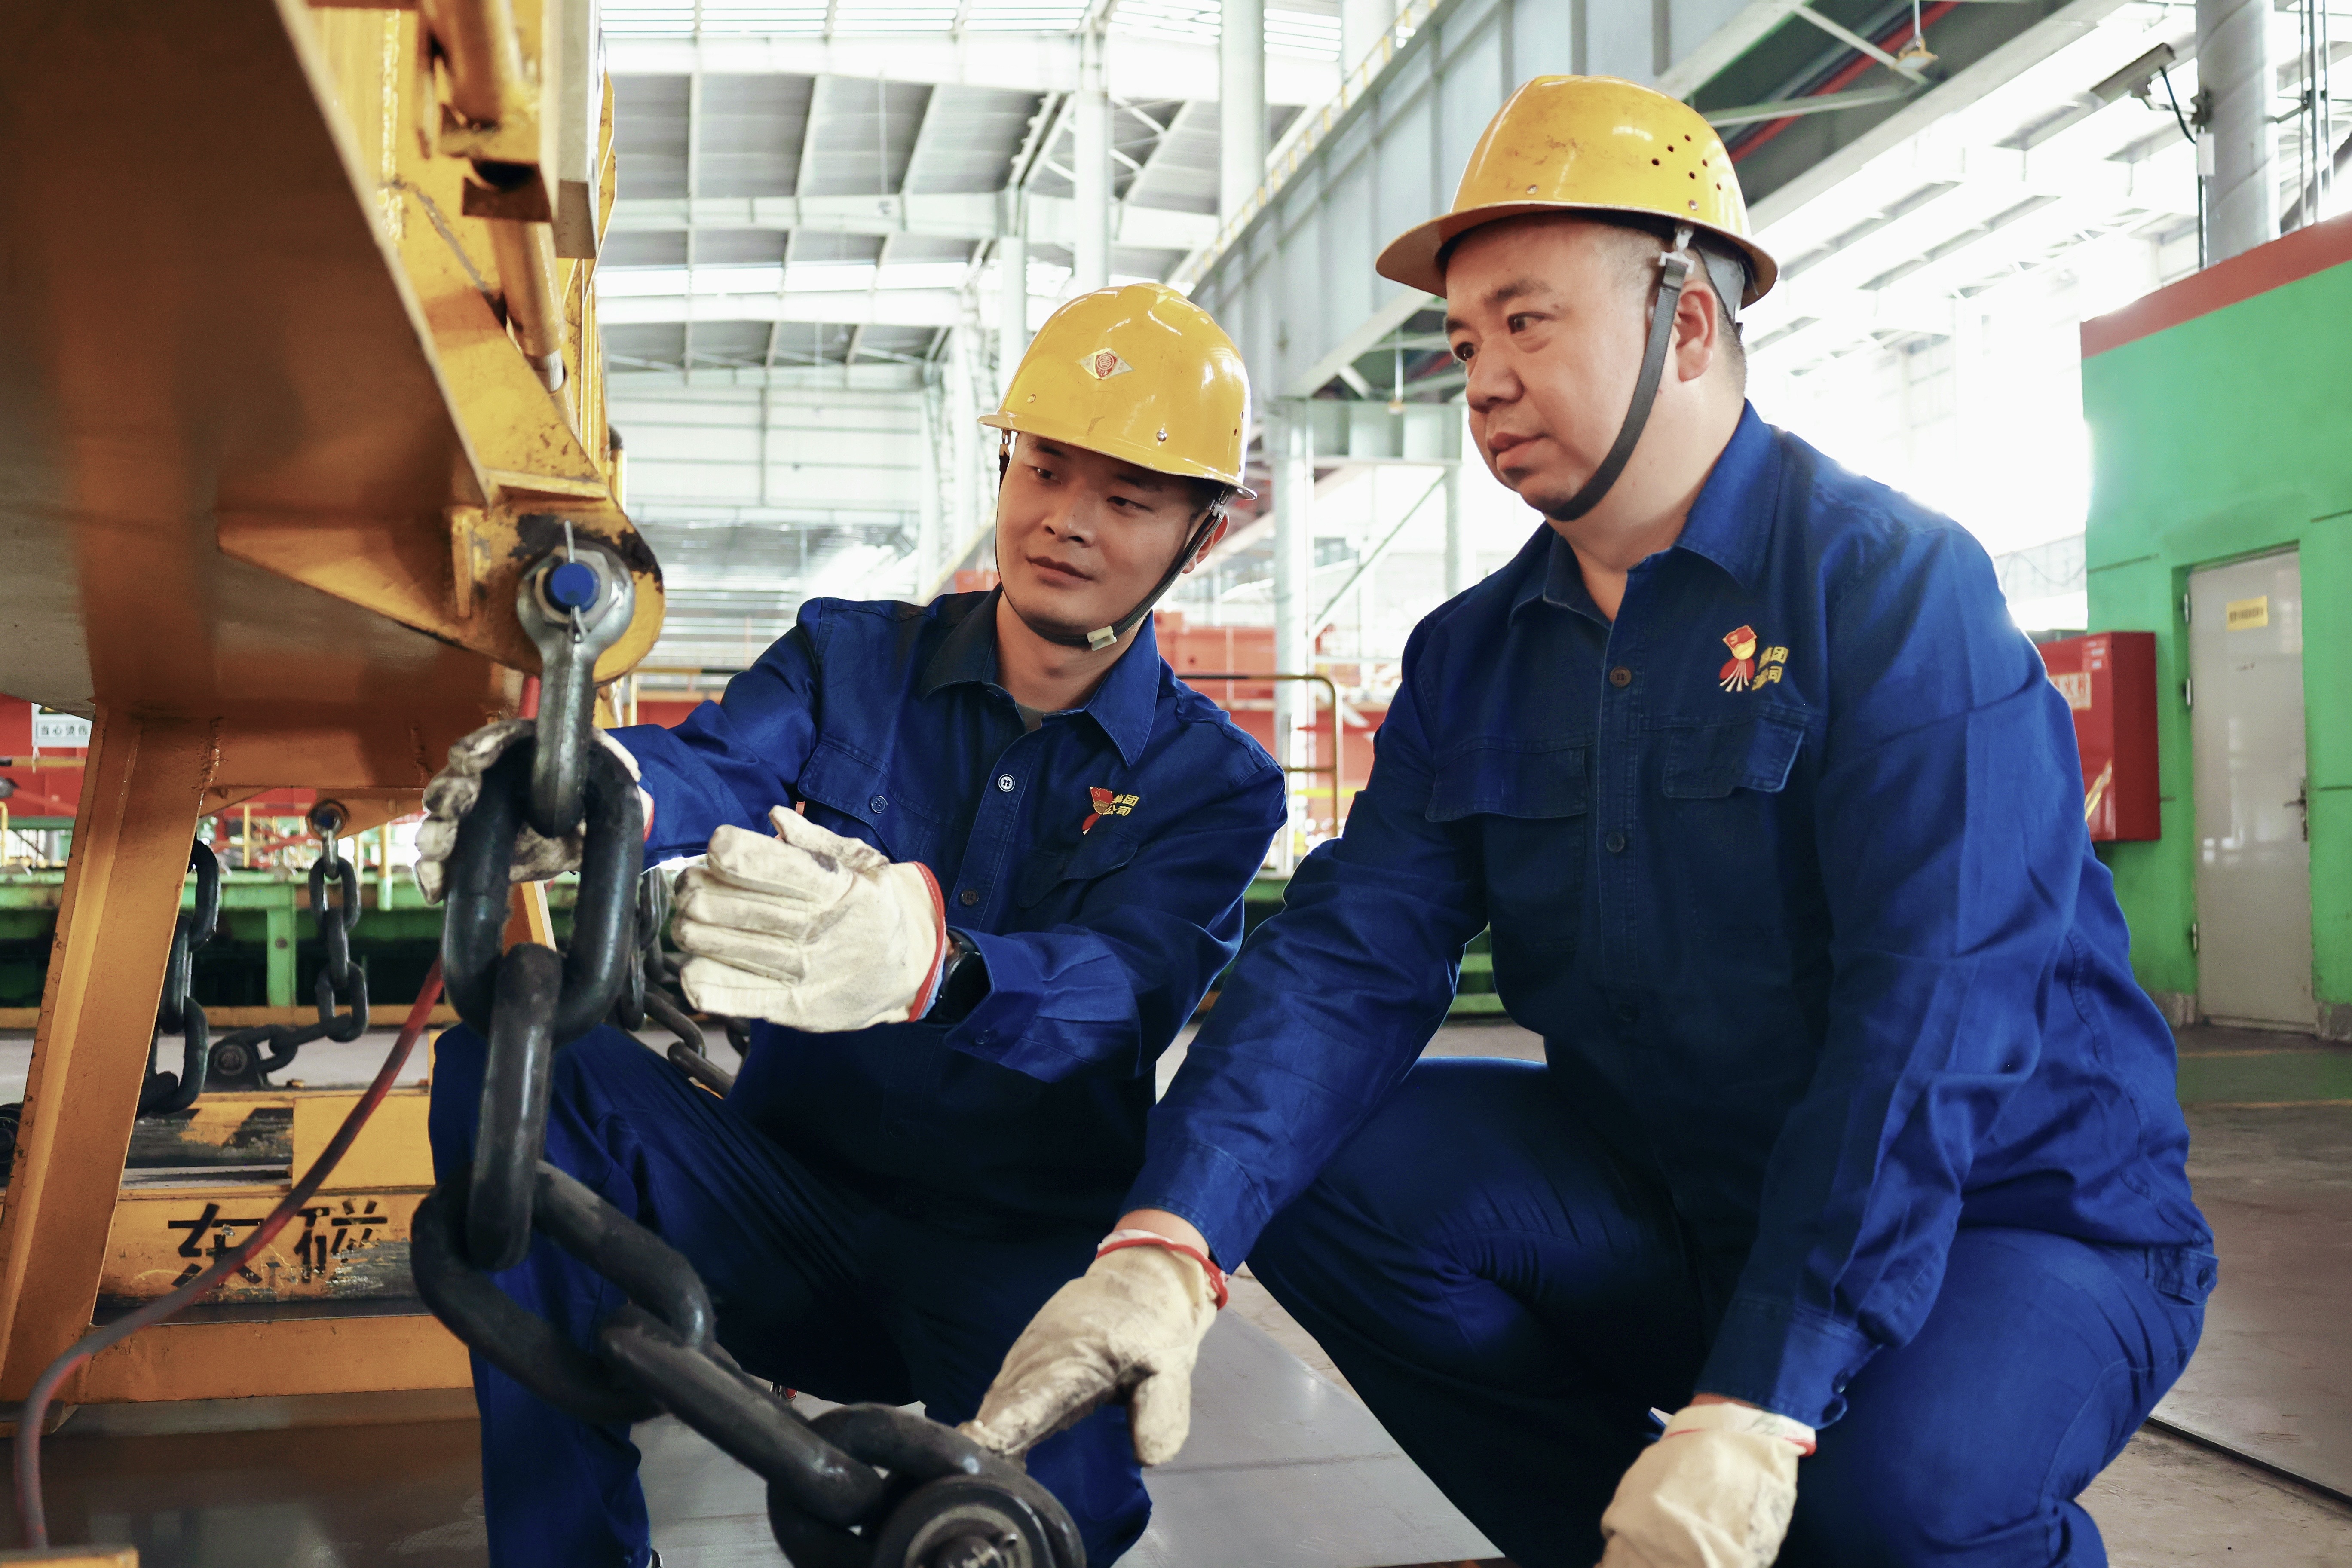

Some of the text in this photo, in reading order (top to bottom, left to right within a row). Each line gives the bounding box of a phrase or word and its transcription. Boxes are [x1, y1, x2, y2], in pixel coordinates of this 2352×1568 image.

[1758, 646, 1789, 671] 团
[1752, 665, 1782, 691] 司
[1102, 805, 1132, 816] 公司
